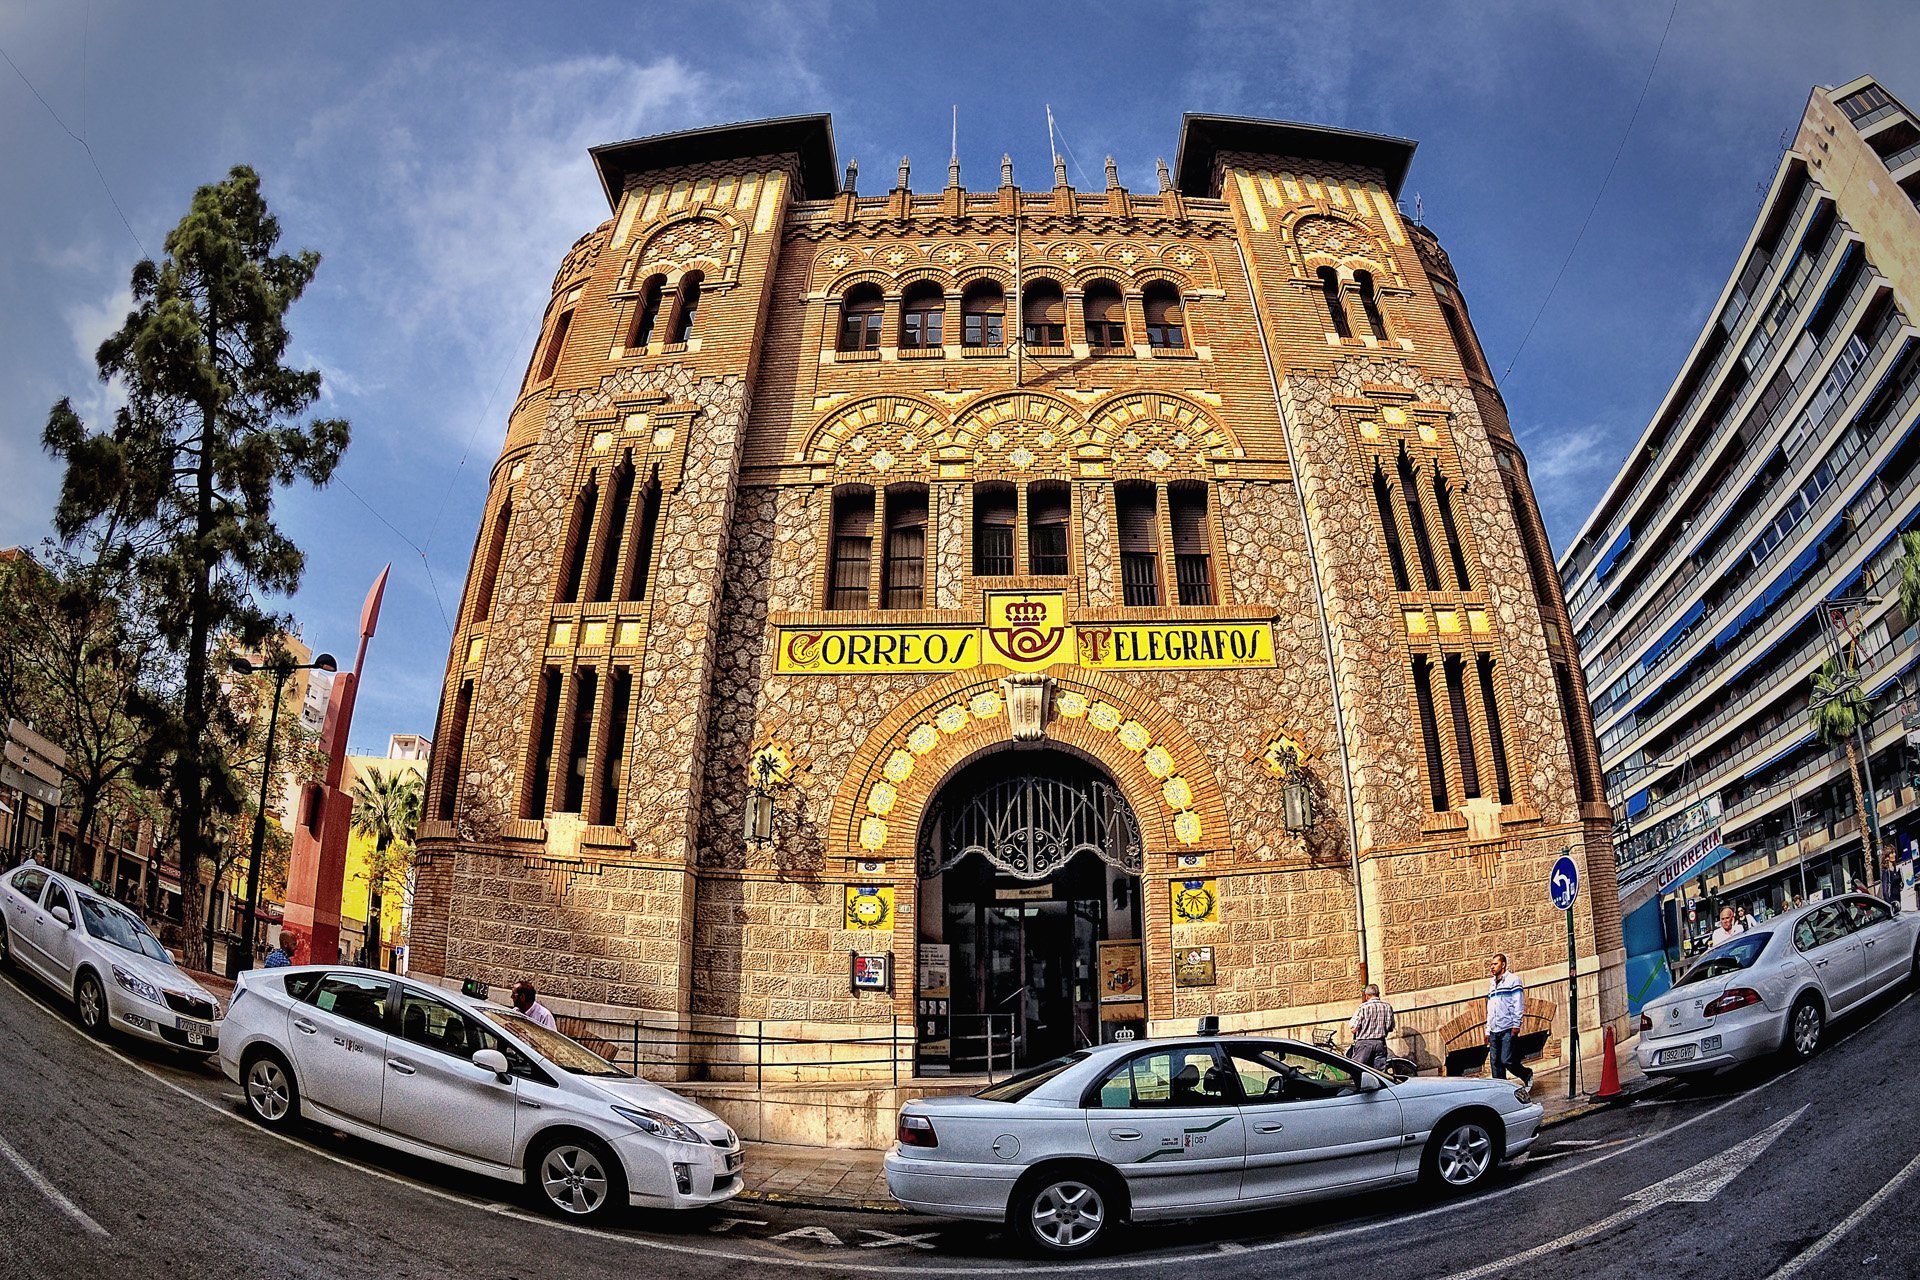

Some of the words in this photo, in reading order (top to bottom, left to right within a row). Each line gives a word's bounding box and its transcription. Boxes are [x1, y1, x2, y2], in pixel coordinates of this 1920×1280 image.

[787, 631, 974, 668] CORREOS
[1077, 627, 1260, 664] TELEGRAFOS
[1658, 831, 1720, 887] CHURRERIA
[189, 1032, 202, 1044] SP
[1703, 1036, 1720, 1050] SP
[1664, 1049, 1678, 1060] 1992
[1194, 1135, 1207, 1144] 087
